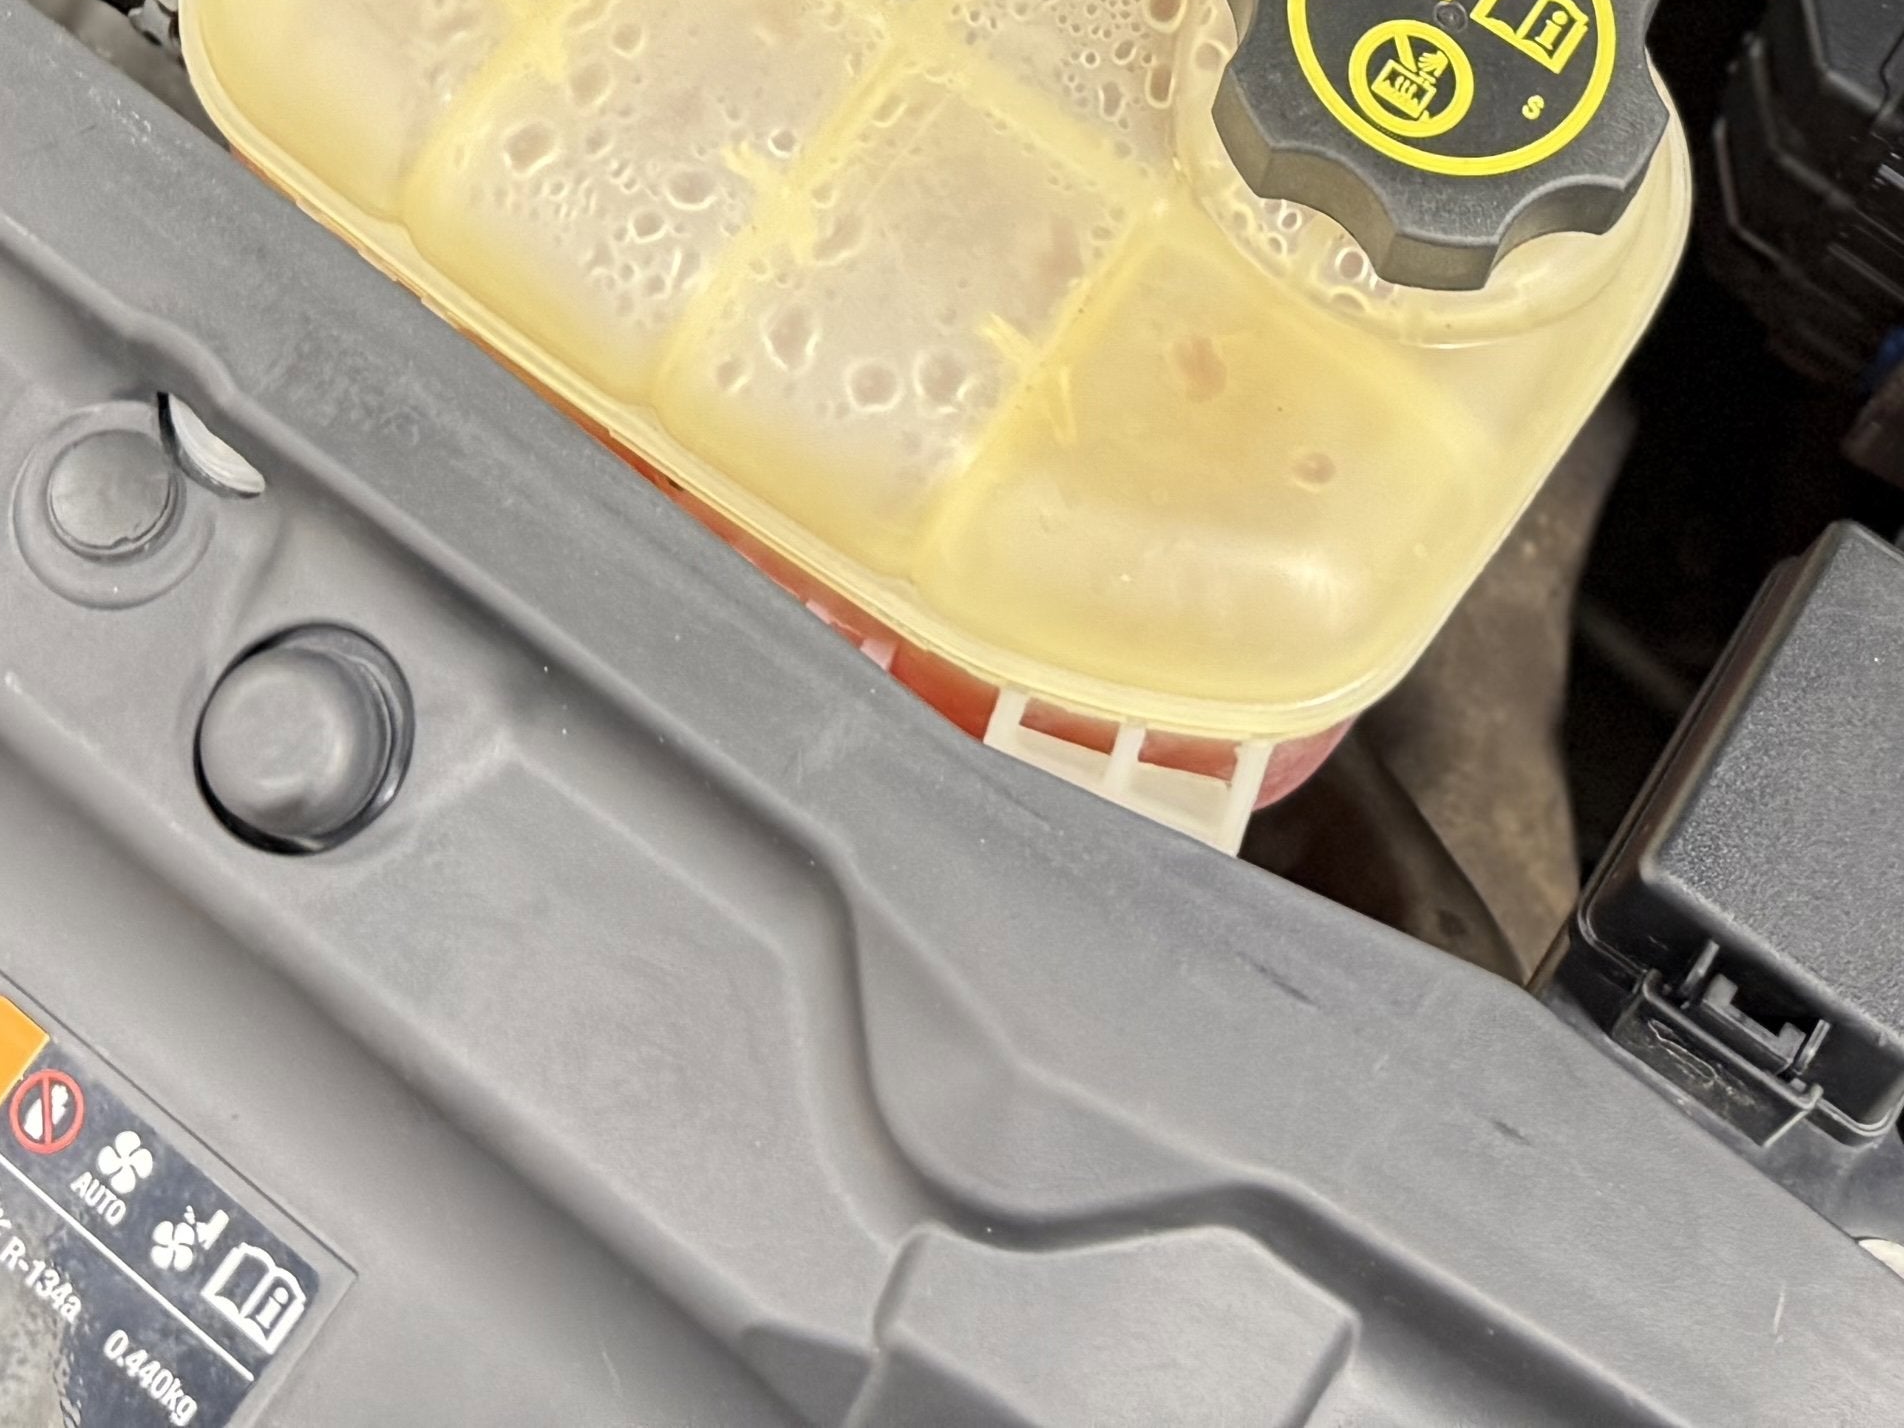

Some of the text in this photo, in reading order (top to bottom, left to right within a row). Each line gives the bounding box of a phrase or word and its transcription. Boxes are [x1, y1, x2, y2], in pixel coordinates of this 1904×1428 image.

[1521, 95, 1545, 121] S
[69, 1170, 128, 1225] AUTO
[102, 1329, 199, 1427] 0.440kg
